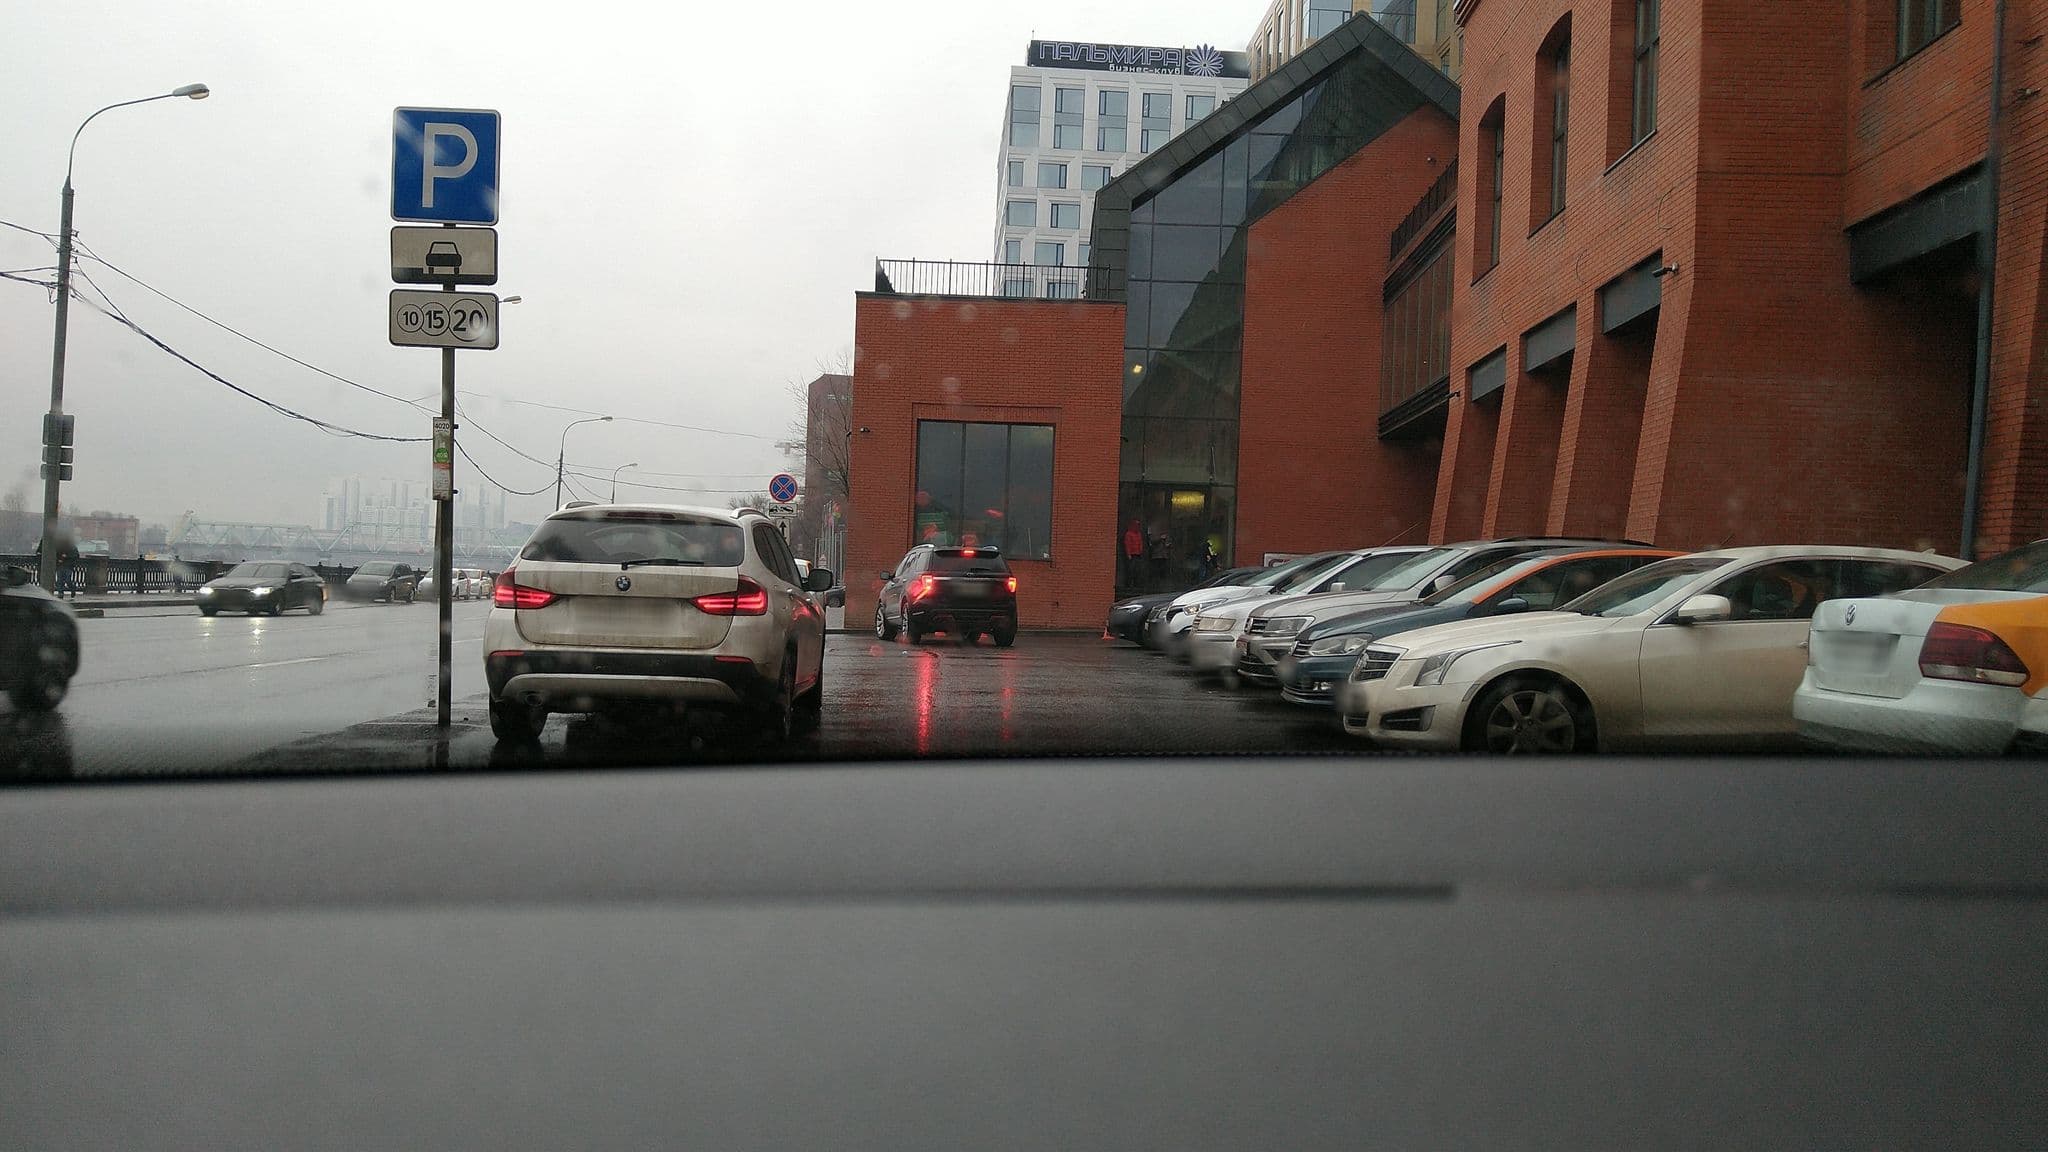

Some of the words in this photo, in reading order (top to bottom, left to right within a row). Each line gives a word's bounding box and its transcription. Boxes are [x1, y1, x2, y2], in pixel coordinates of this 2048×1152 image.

[1039, 41, 1181, 66] ПАЛЬМИРА
[1109, 63, 1181, 75] бизнес-клуб
[421, 122, 479, 208] P
[402, 310, 419, 327] 10
[425, 309, 445, 329] 15
[452, 309, 483, 332] 20
